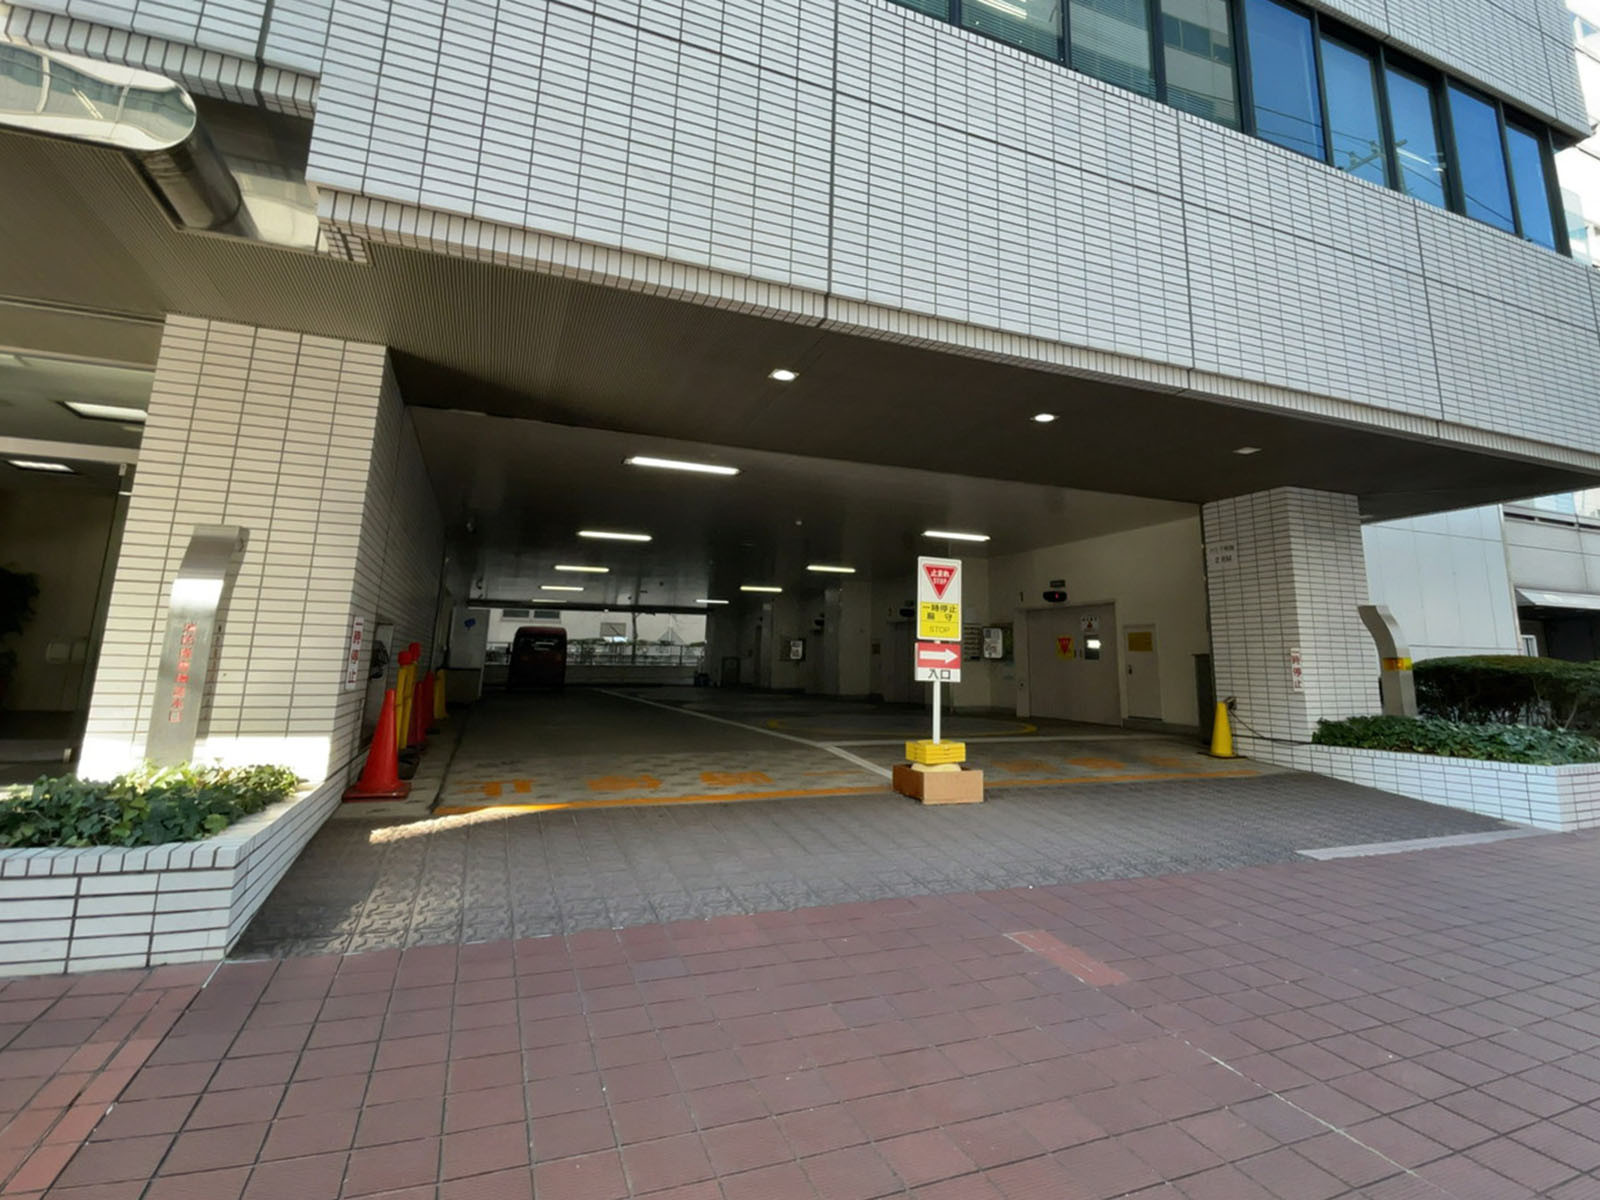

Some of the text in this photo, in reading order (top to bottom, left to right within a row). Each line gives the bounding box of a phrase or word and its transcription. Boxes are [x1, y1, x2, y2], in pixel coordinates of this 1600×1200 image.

[922, 604, 957, 613] 一時停止
[929, 626, 950, 634] STOP
[348, 623, 363, 683] 一時停止
[928, 669, 951, 680] 入口
